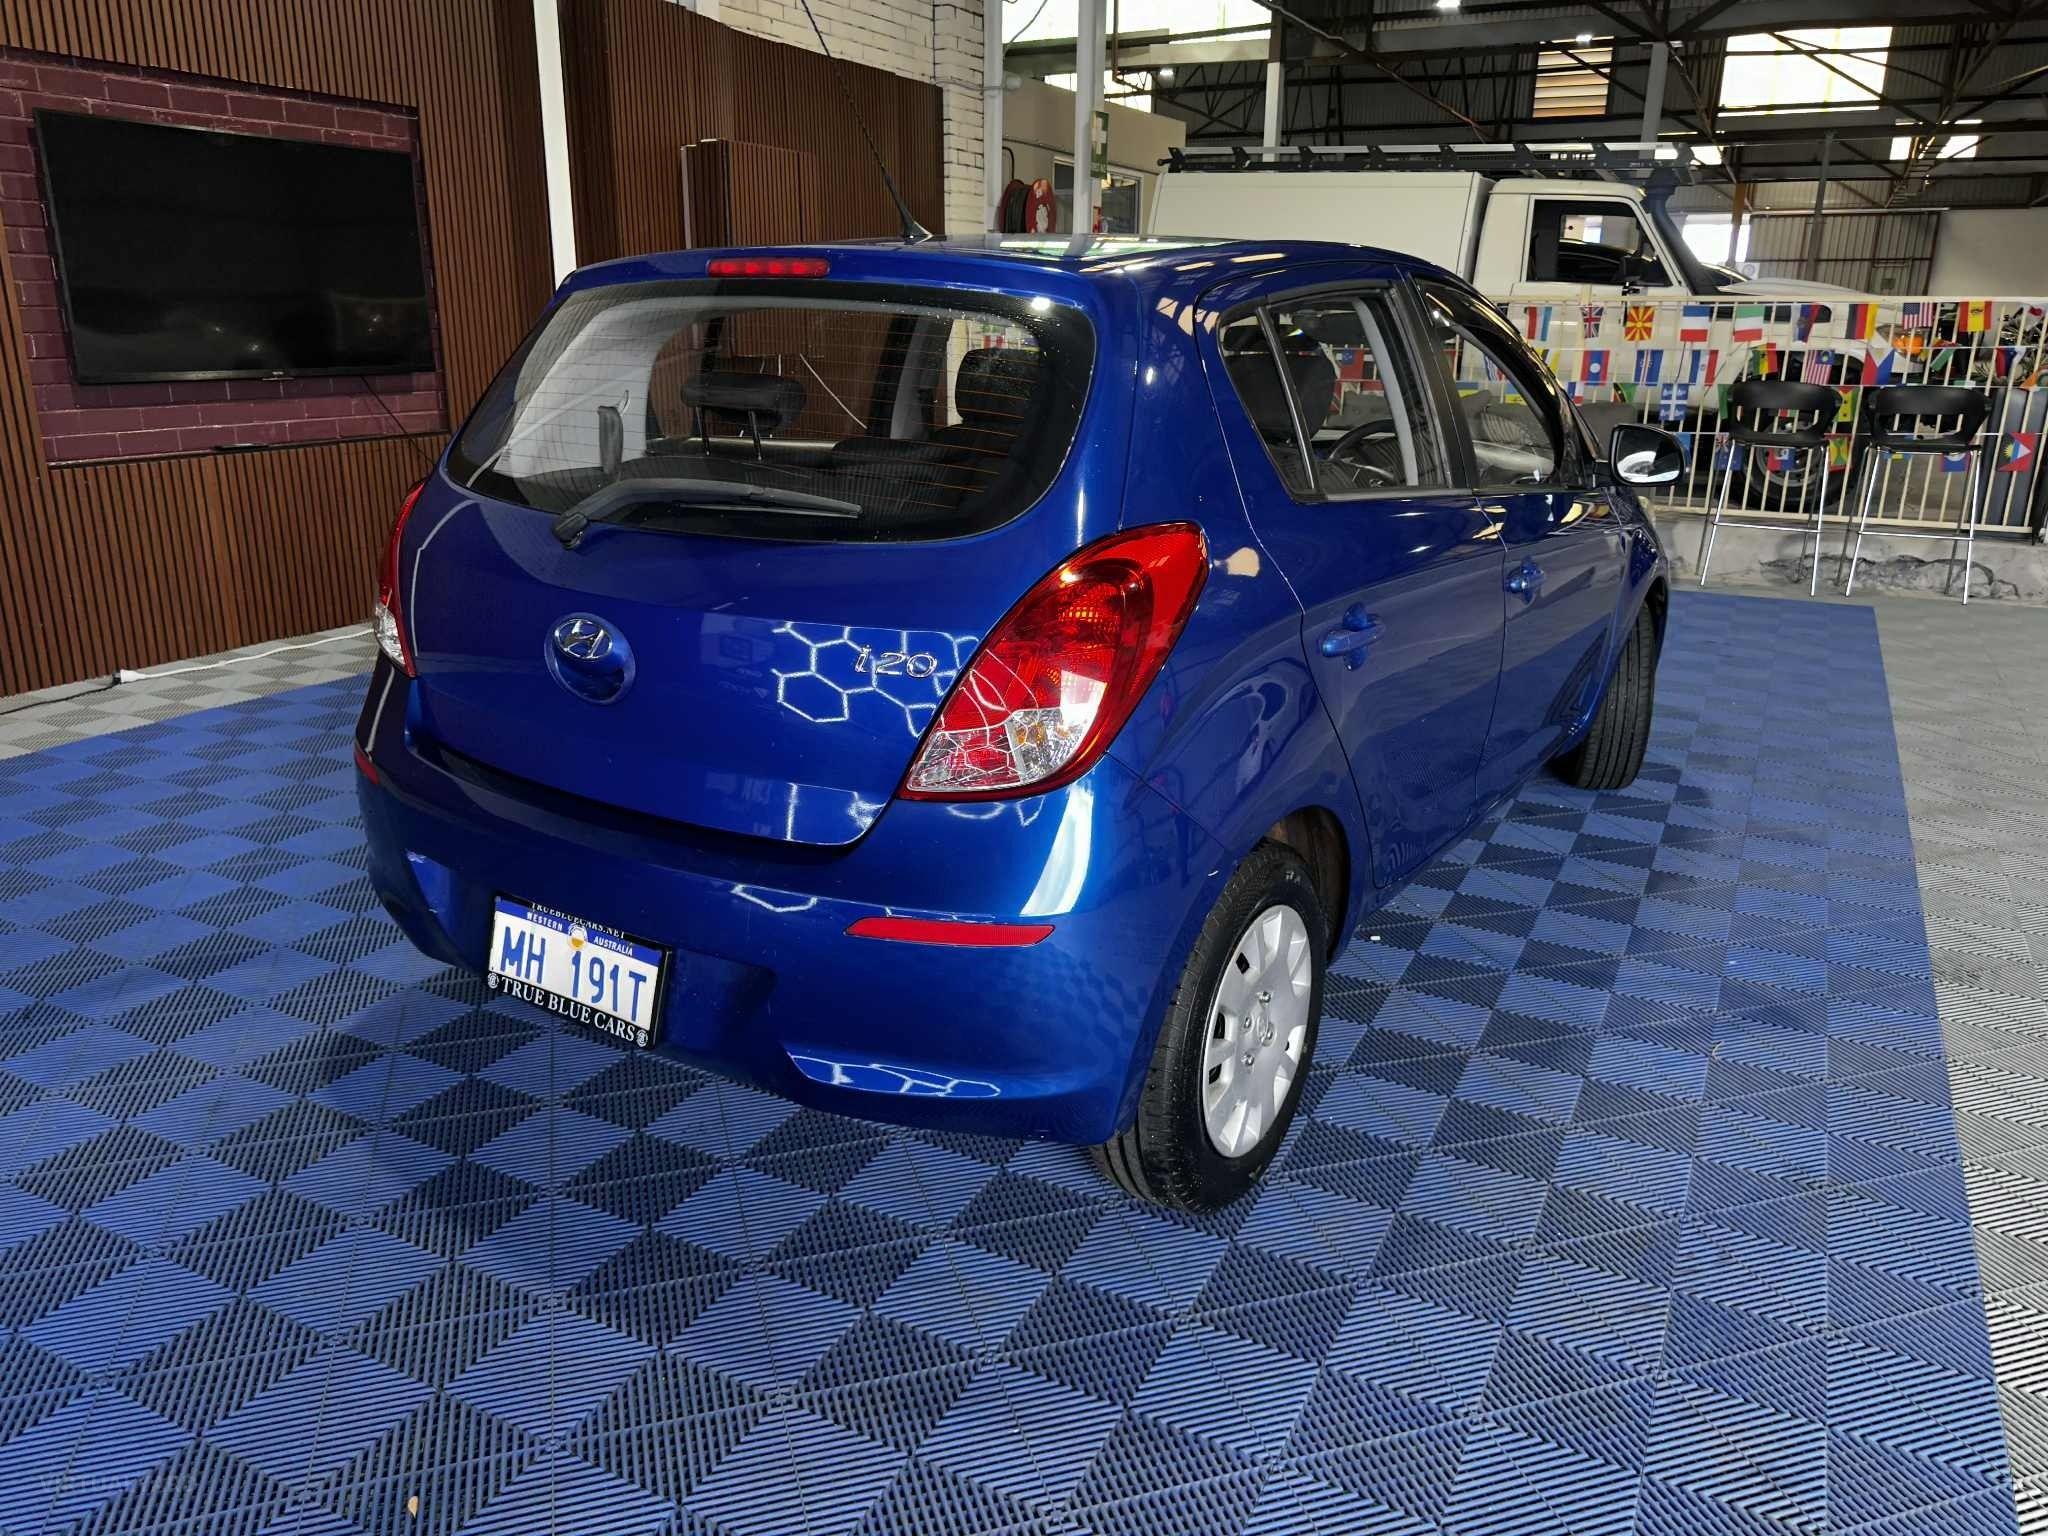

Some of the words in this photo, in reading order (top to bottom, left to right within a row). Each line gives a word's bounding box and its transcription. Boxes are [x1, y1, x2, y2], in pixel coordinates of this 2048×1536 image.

[854, 643, 938, 678] i20
[526, 912, 563, 931] WESTERN
[593, 936, 633, 957] AUSTRALIA
[500, 926, 546, 985] MH
[571, 950, 647, 1023] 191T
[501, 977, 545, 1006] TRUE
[547, 994, 592, 1024] BLUE
[594, 1011, 636, 1042] CARS
